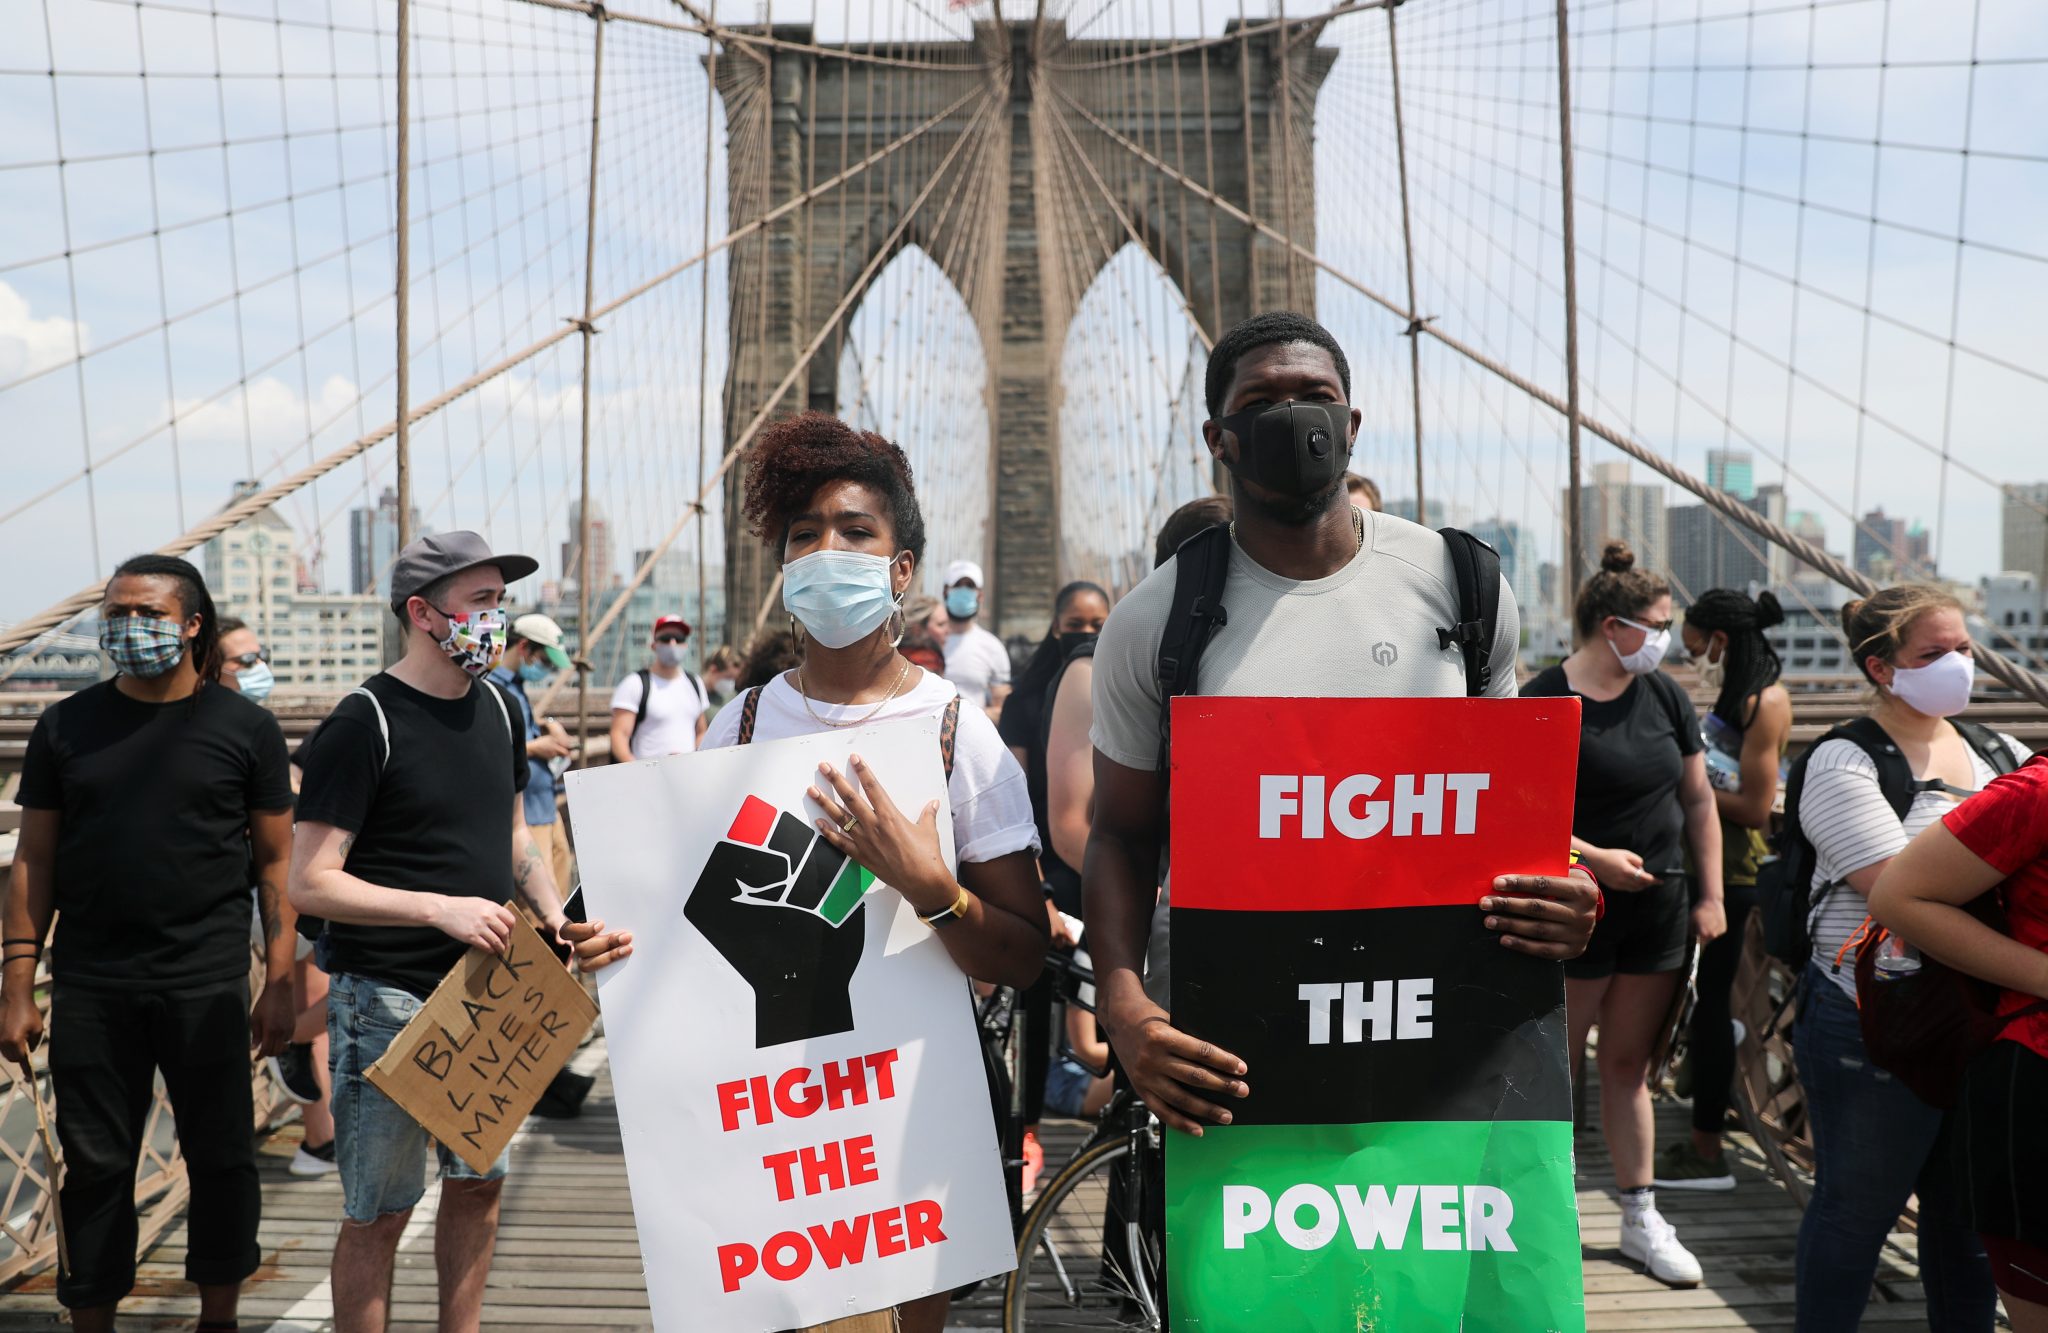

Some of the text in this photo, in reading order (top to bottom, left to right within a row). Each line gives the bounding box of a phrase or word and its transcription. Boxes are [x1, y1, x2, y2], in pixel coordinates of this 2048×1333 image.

[1259, 773, 1490, 840] FIGHT
[413, 944, 533, 1082] BLACK
[448, 986, 545, 1112] LIVES
[1298, 978, 1434, 1045] THE
[461, 1010, 570, 1150] MATTER
[716, 1049, 899, 1132] FIGHT
[762, 1134, 879, 1202] THE
[717, 1199, 948, 1293] POWER
[1222, 1183, 1519, 1252] POWER
